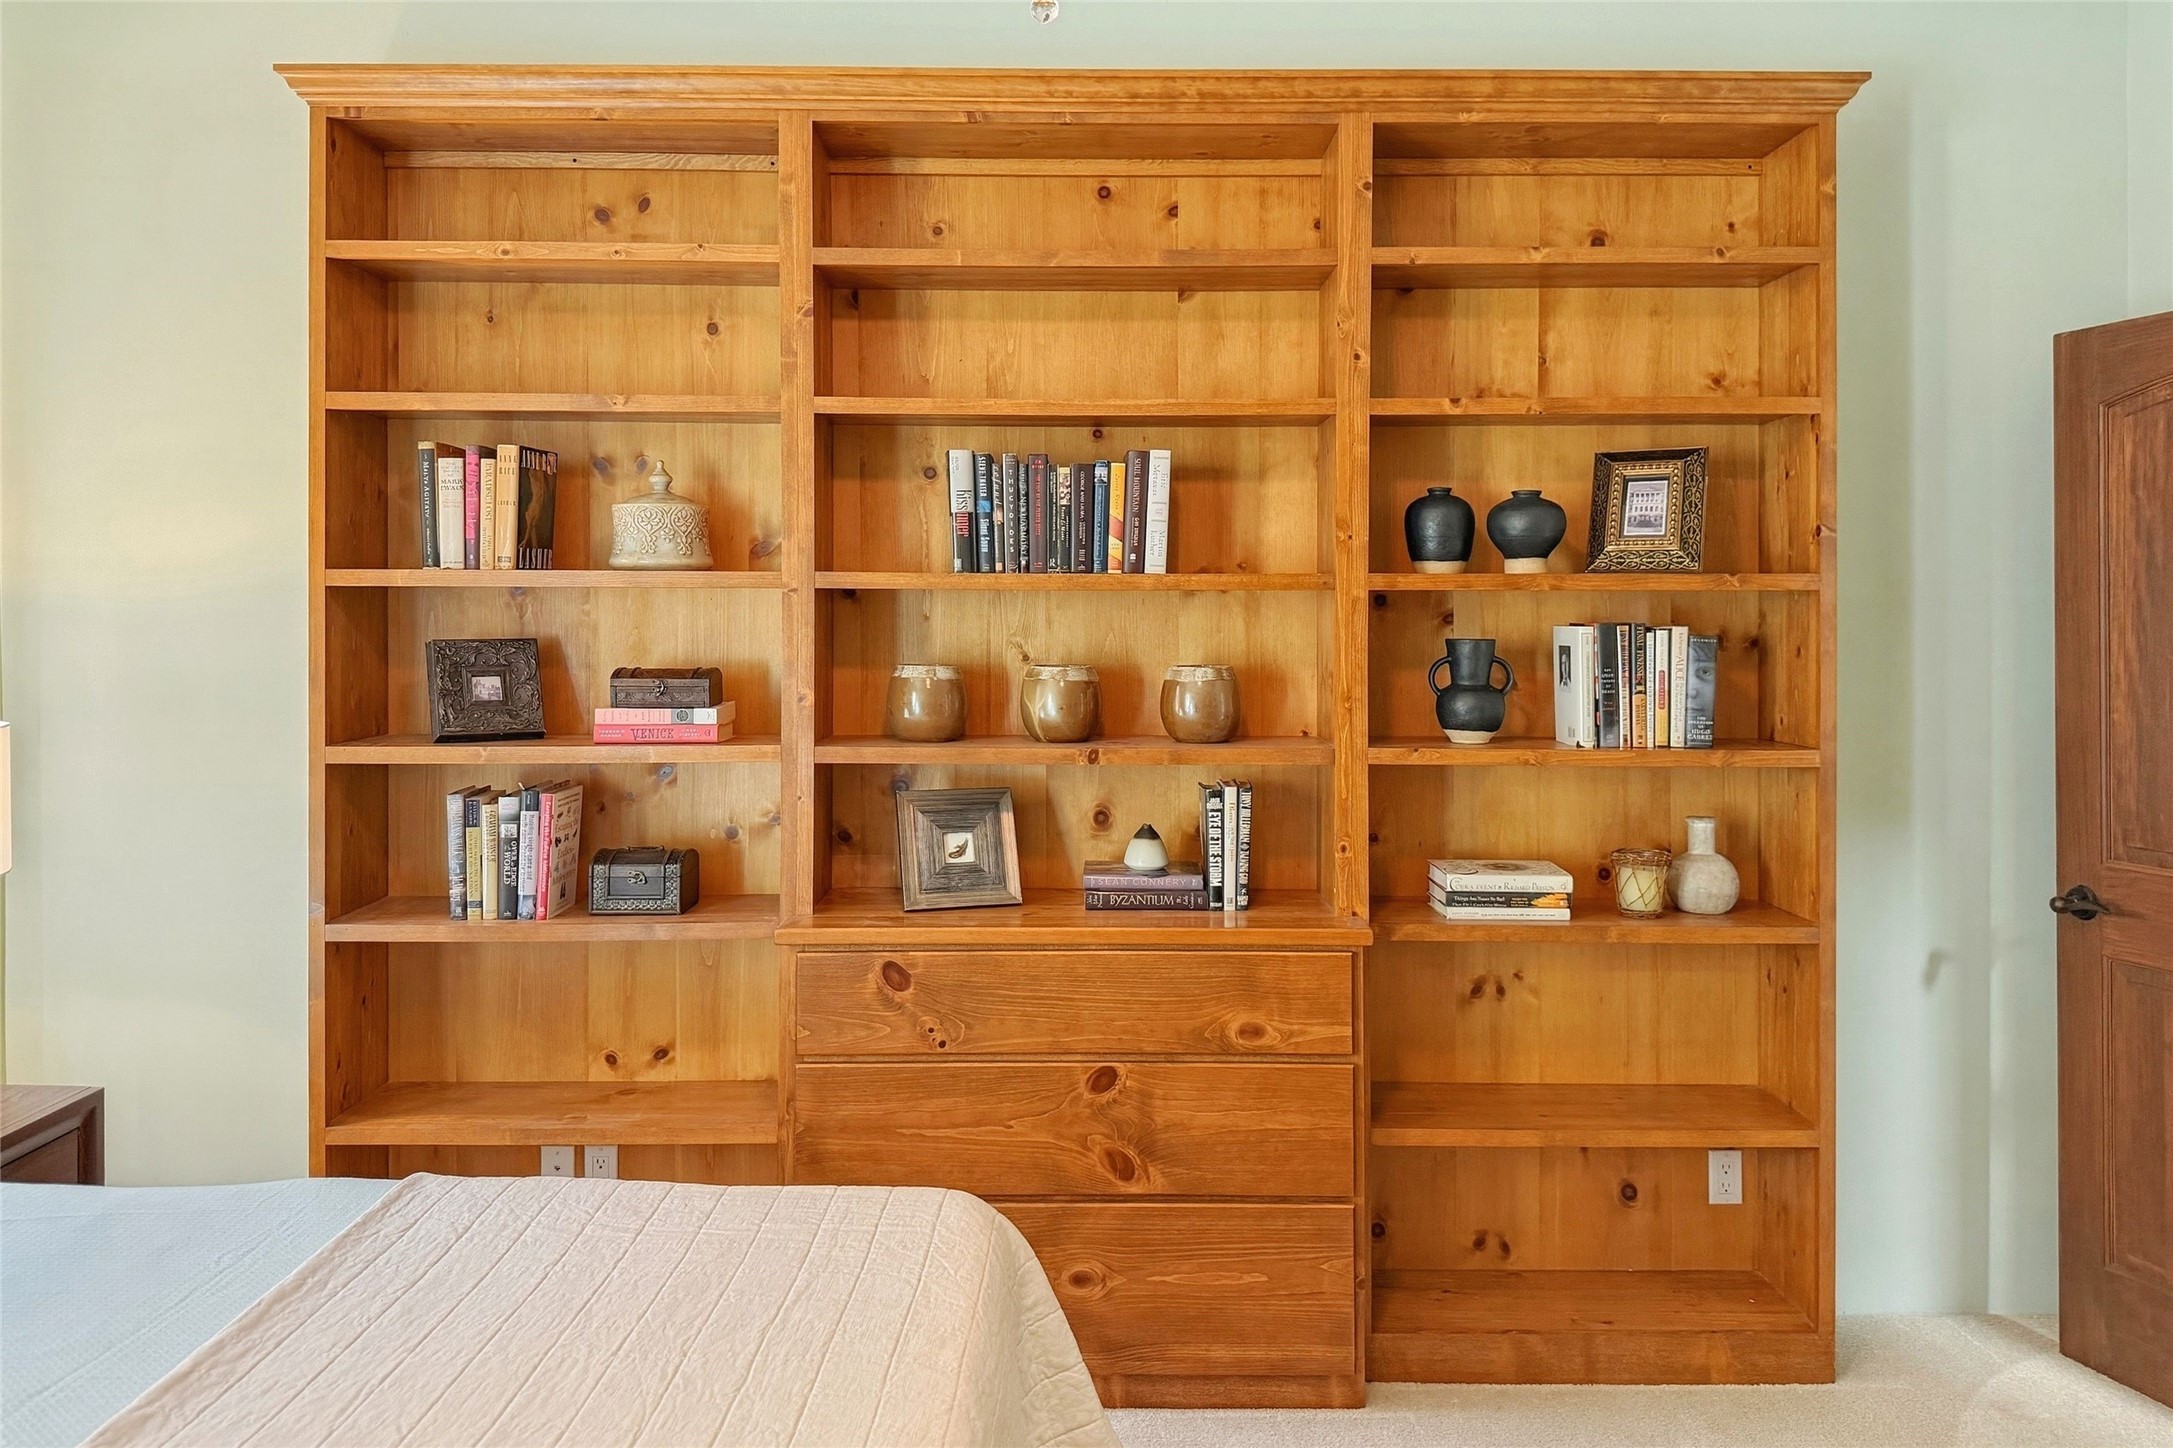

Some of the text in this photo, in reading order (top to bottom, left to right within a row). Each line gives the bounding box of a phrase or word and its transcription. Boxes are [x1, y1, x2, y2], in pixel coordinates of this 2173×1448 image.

[1132, 458, 1142, 513] SOUL MOUNTAIN
[1208, 812, 1222, 827] EYE
[1210, 856, 1222, 886] STORM
[1098, 878, 1186, 886] SEAN CONNERY
[1110, 894, 1174, 906] BYZANTIUM
